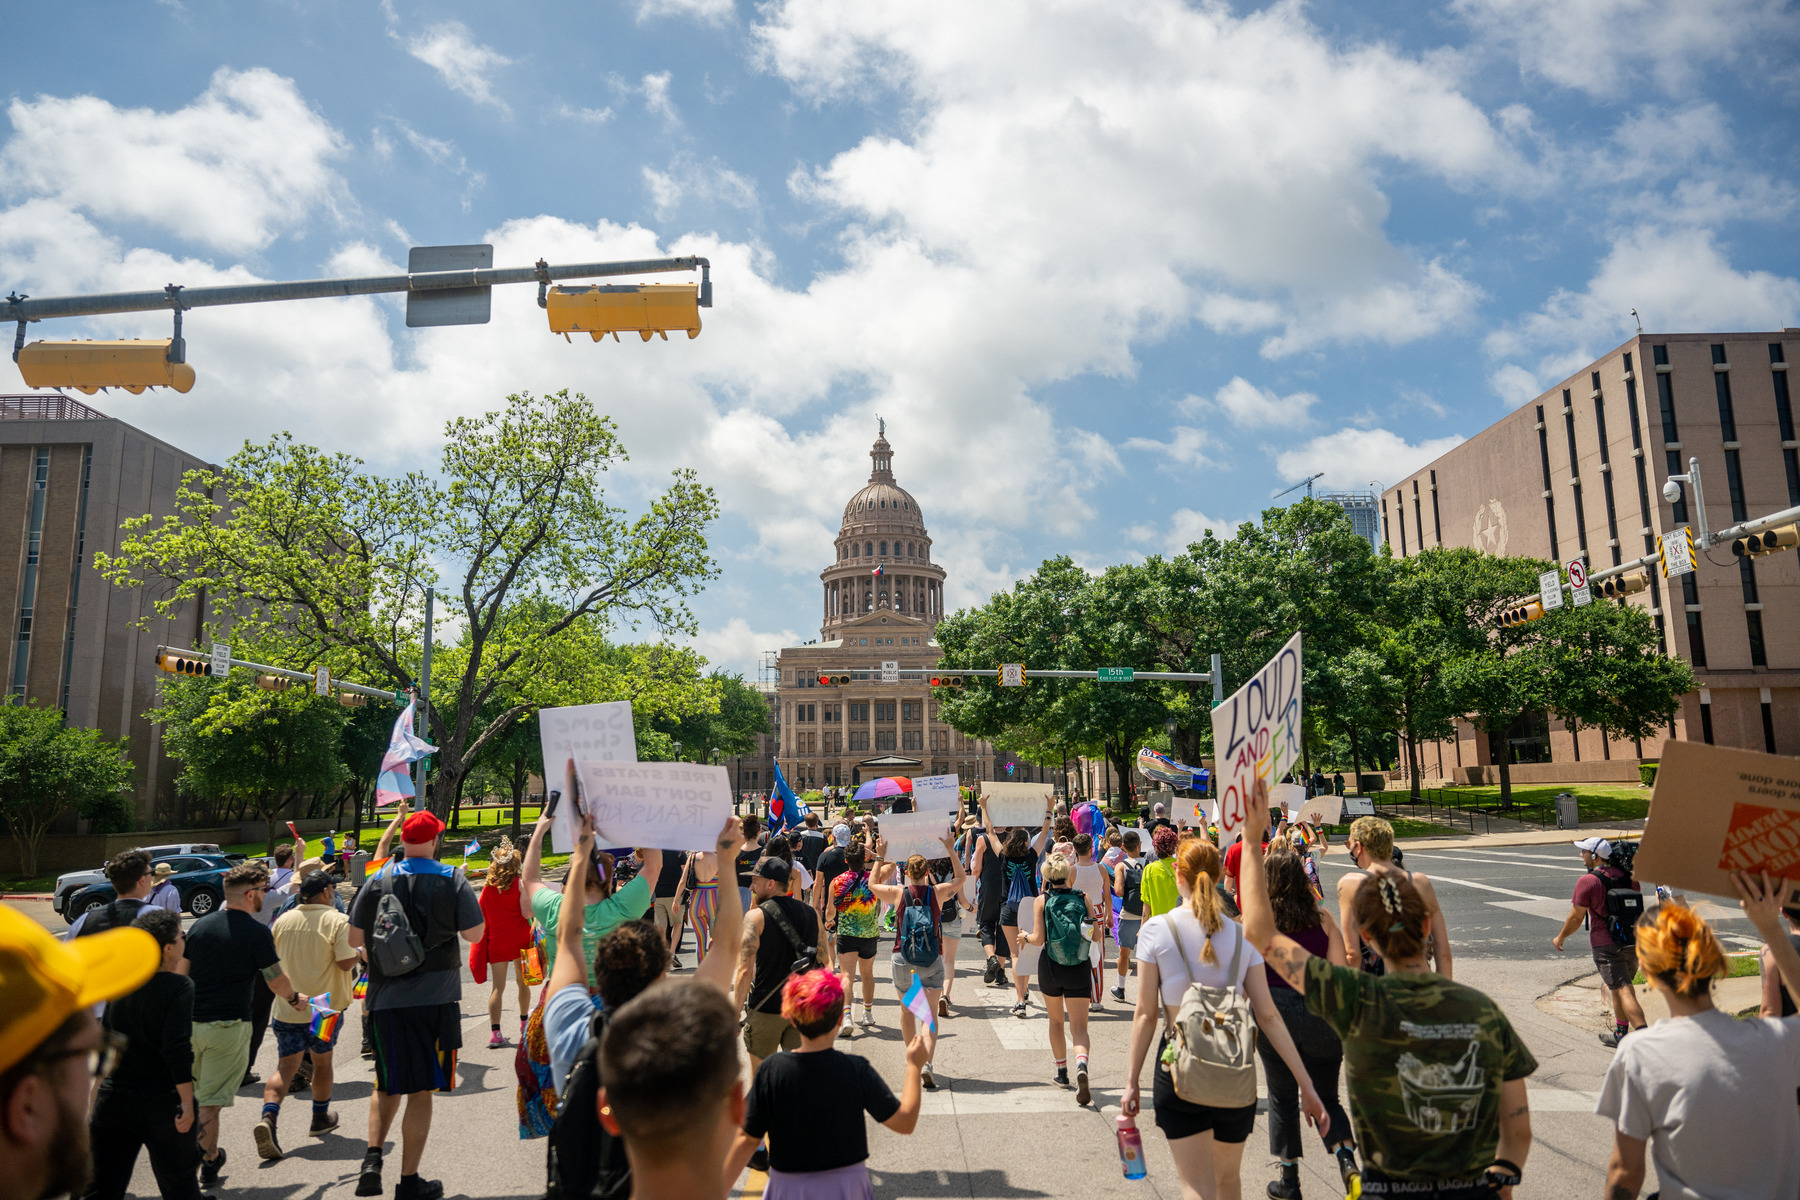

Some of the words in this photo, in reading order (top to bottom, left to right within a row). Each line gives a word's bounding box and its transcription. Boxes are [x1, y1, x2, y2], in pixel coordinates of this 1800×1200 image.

[1226, 648, 1297, 760] LOUD
[1222, 698, 1299, 832] QUEER
[1234, 727, 1269, 778] AND
[1748, 785, 1786, 798] doers
[1728, 808, 1790, 846] DEPOT
[1362, 1182, 1388, 1193] AGGU
[1392, 1182, 1433, 1193] BAGGU
[1437, 1178, 1473, 1190] BAGGU
